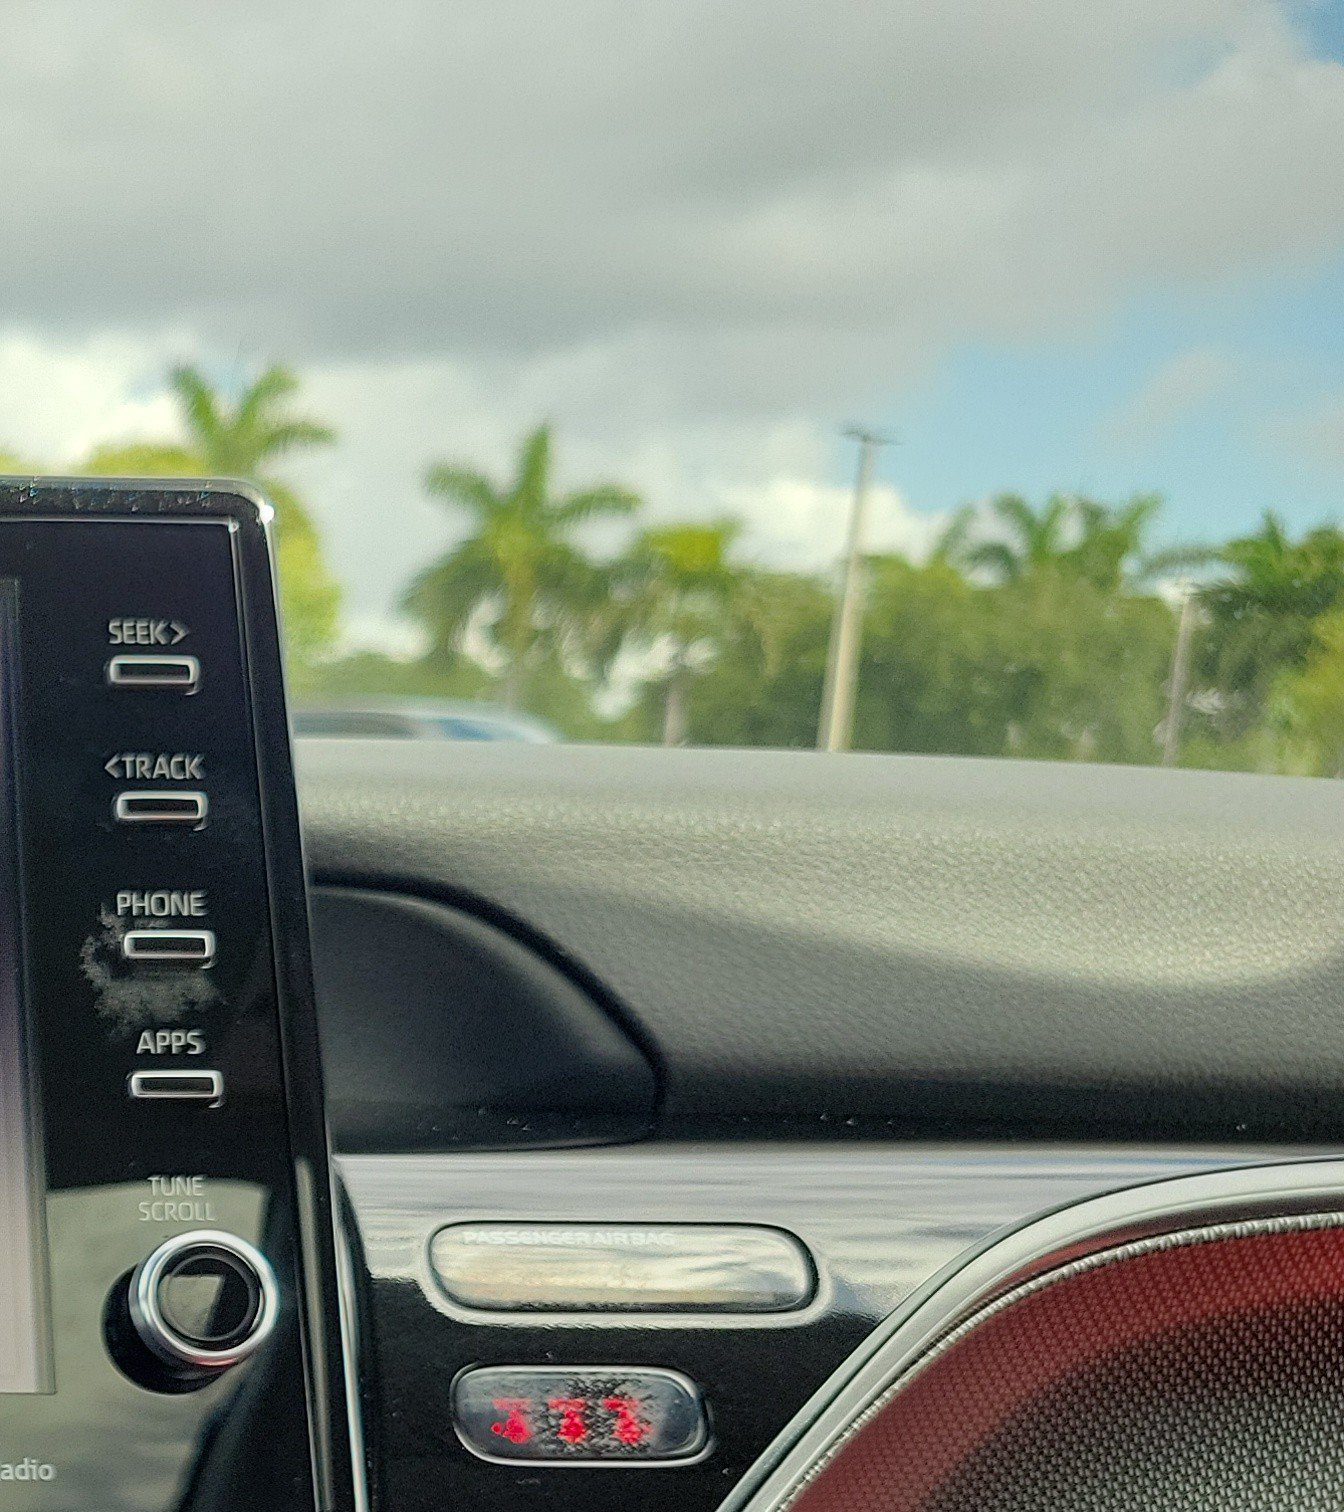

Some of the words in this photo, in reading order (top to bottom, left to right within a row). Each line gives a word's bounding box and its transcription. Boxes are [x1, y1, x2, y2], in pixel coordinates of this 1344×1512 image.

[115, 892, 208, 918] PHONE
[134, 1030, 206, 1057] APPS
[146, 1176, 205, 1198] TUNE
[138, 1200, 217, 1224] SCROLL
